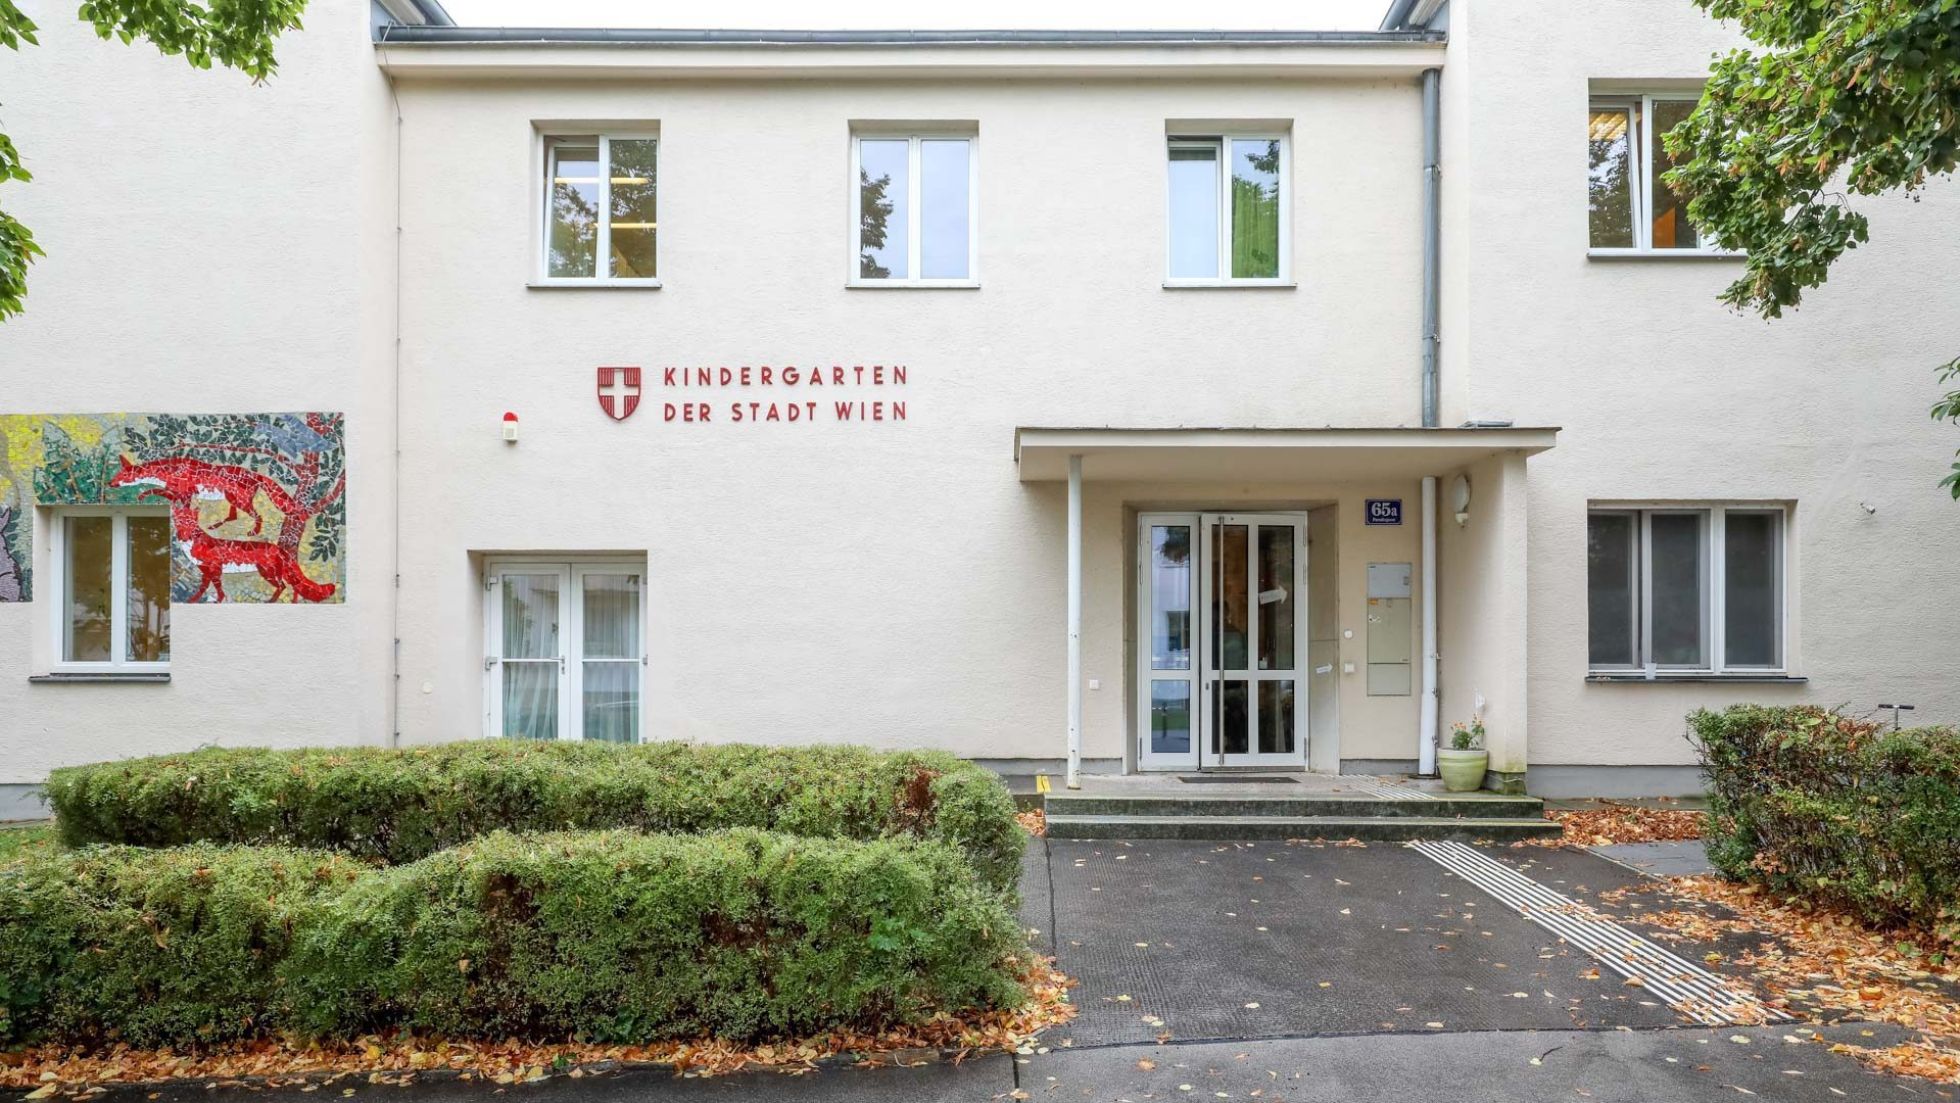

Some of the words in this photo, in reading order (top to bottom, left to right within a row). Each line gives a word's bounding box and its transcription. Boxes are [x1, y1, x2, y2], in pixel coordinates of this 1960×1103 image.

[664, 366, 907, 386] KINDERGARTEN
[664, 402, 711, 422] DER
[731, 402, 817, 422] STADT
[834, 401, 906, 421] WIEN
[1371, 502, 1397, 517] 65a
